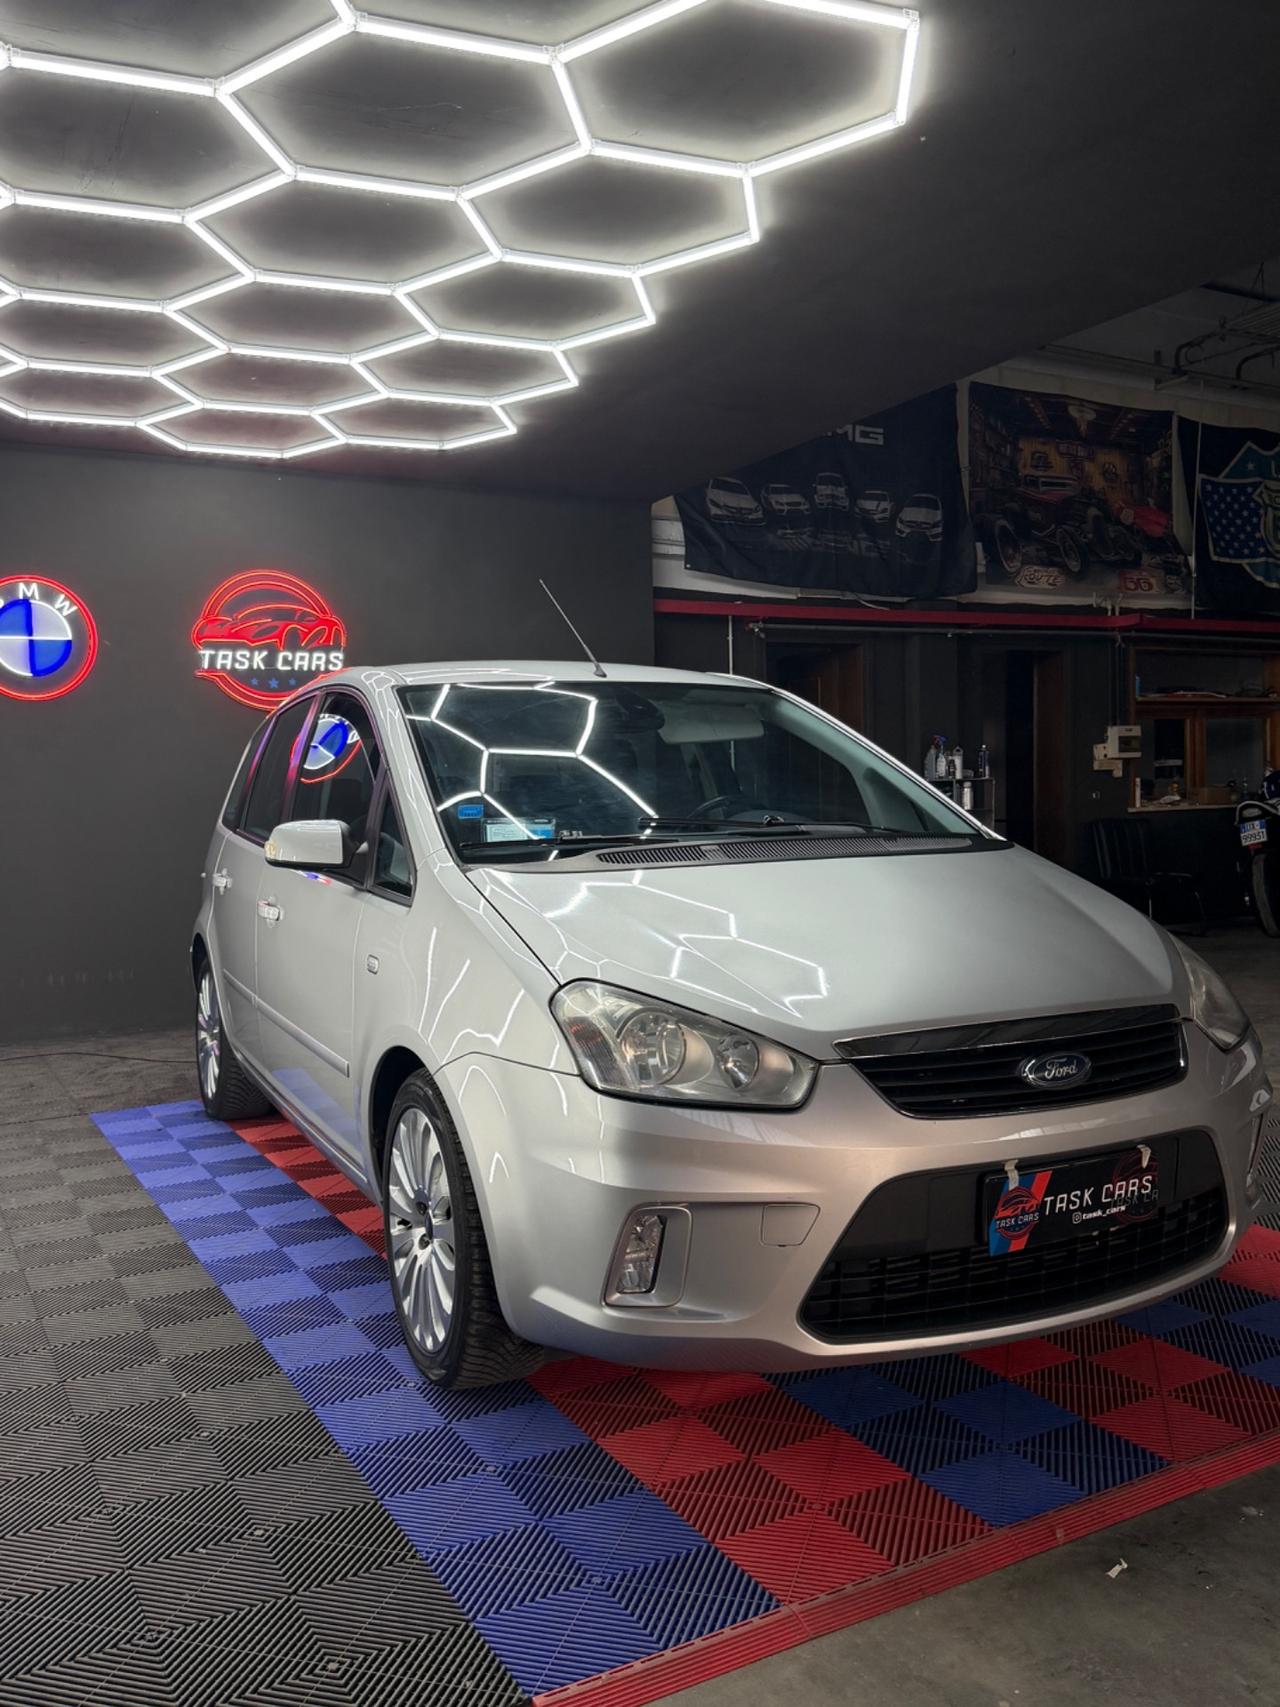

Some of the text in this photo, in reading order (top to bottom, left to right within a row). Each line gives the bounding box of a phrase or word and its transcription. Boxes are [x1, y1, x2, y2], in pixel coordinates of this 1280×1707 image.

[198, 649, 344, 672] TASK CARS
[1043, 1058, 1078, 1079] Ford
[1044, 1175, 1154, 1216] TASK CARS
[996, 1212, 1040, 1229] TASK CARS
